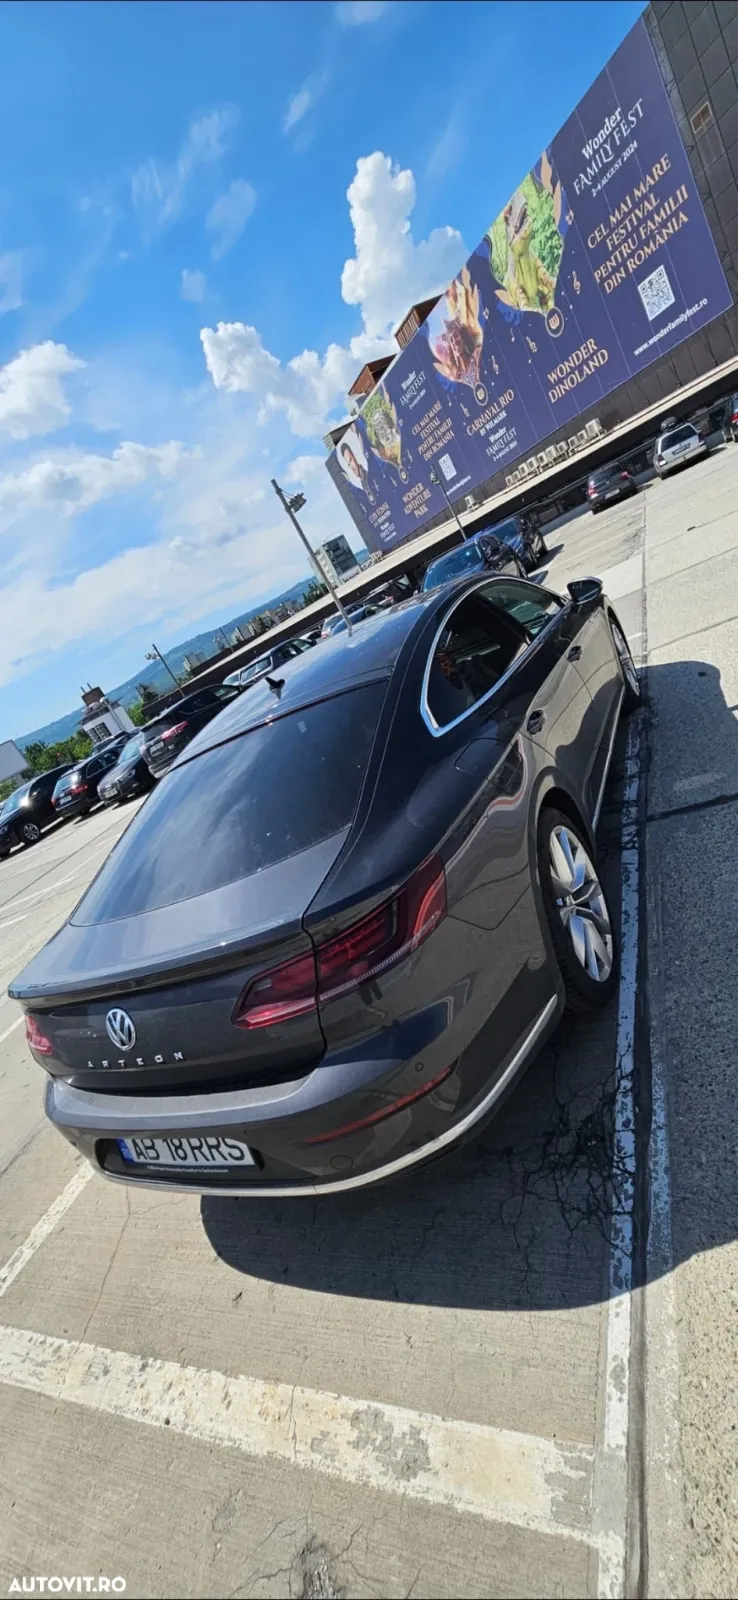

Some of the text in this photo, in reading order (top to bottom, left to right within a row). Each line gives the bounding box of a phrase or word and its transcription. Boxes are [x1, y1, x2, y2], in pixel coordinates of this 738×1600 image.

[573, 98, 644, 195] FAMILY FEST
[582, 108, 622, 160] Wonder
[601, 158, 623, 187] AUGUST
[621, 140, 637, 161] 2024
[588, 154, 671, 249] CEL MAI MARE
[606, 193, 660, 251] FESTIVAL
[594, 185, 689, 283] PENTRU FAMILII
[604, 211, 689, 294] DIN ROMÂNIA
[634, 298, 708, 355] www.wonderfamilyfest.ro
[547, 338, 599, 384] WONDER
[549, 349, 609, 404] DINOLAND
[420, 417, 440, 440] FESTIVAL
[467, 390, 514, 436] CARNAVAL RIO
[504, 427, 517, 443] FEST
[402, 482, 424, 503] WONDER
[87, 1051, 185, 1069] ARTEON
[132, 1138, 160, 1160] AB
[163, 1138, 187, 1161] 18
[186, 1138, 245, 1162] RRS
